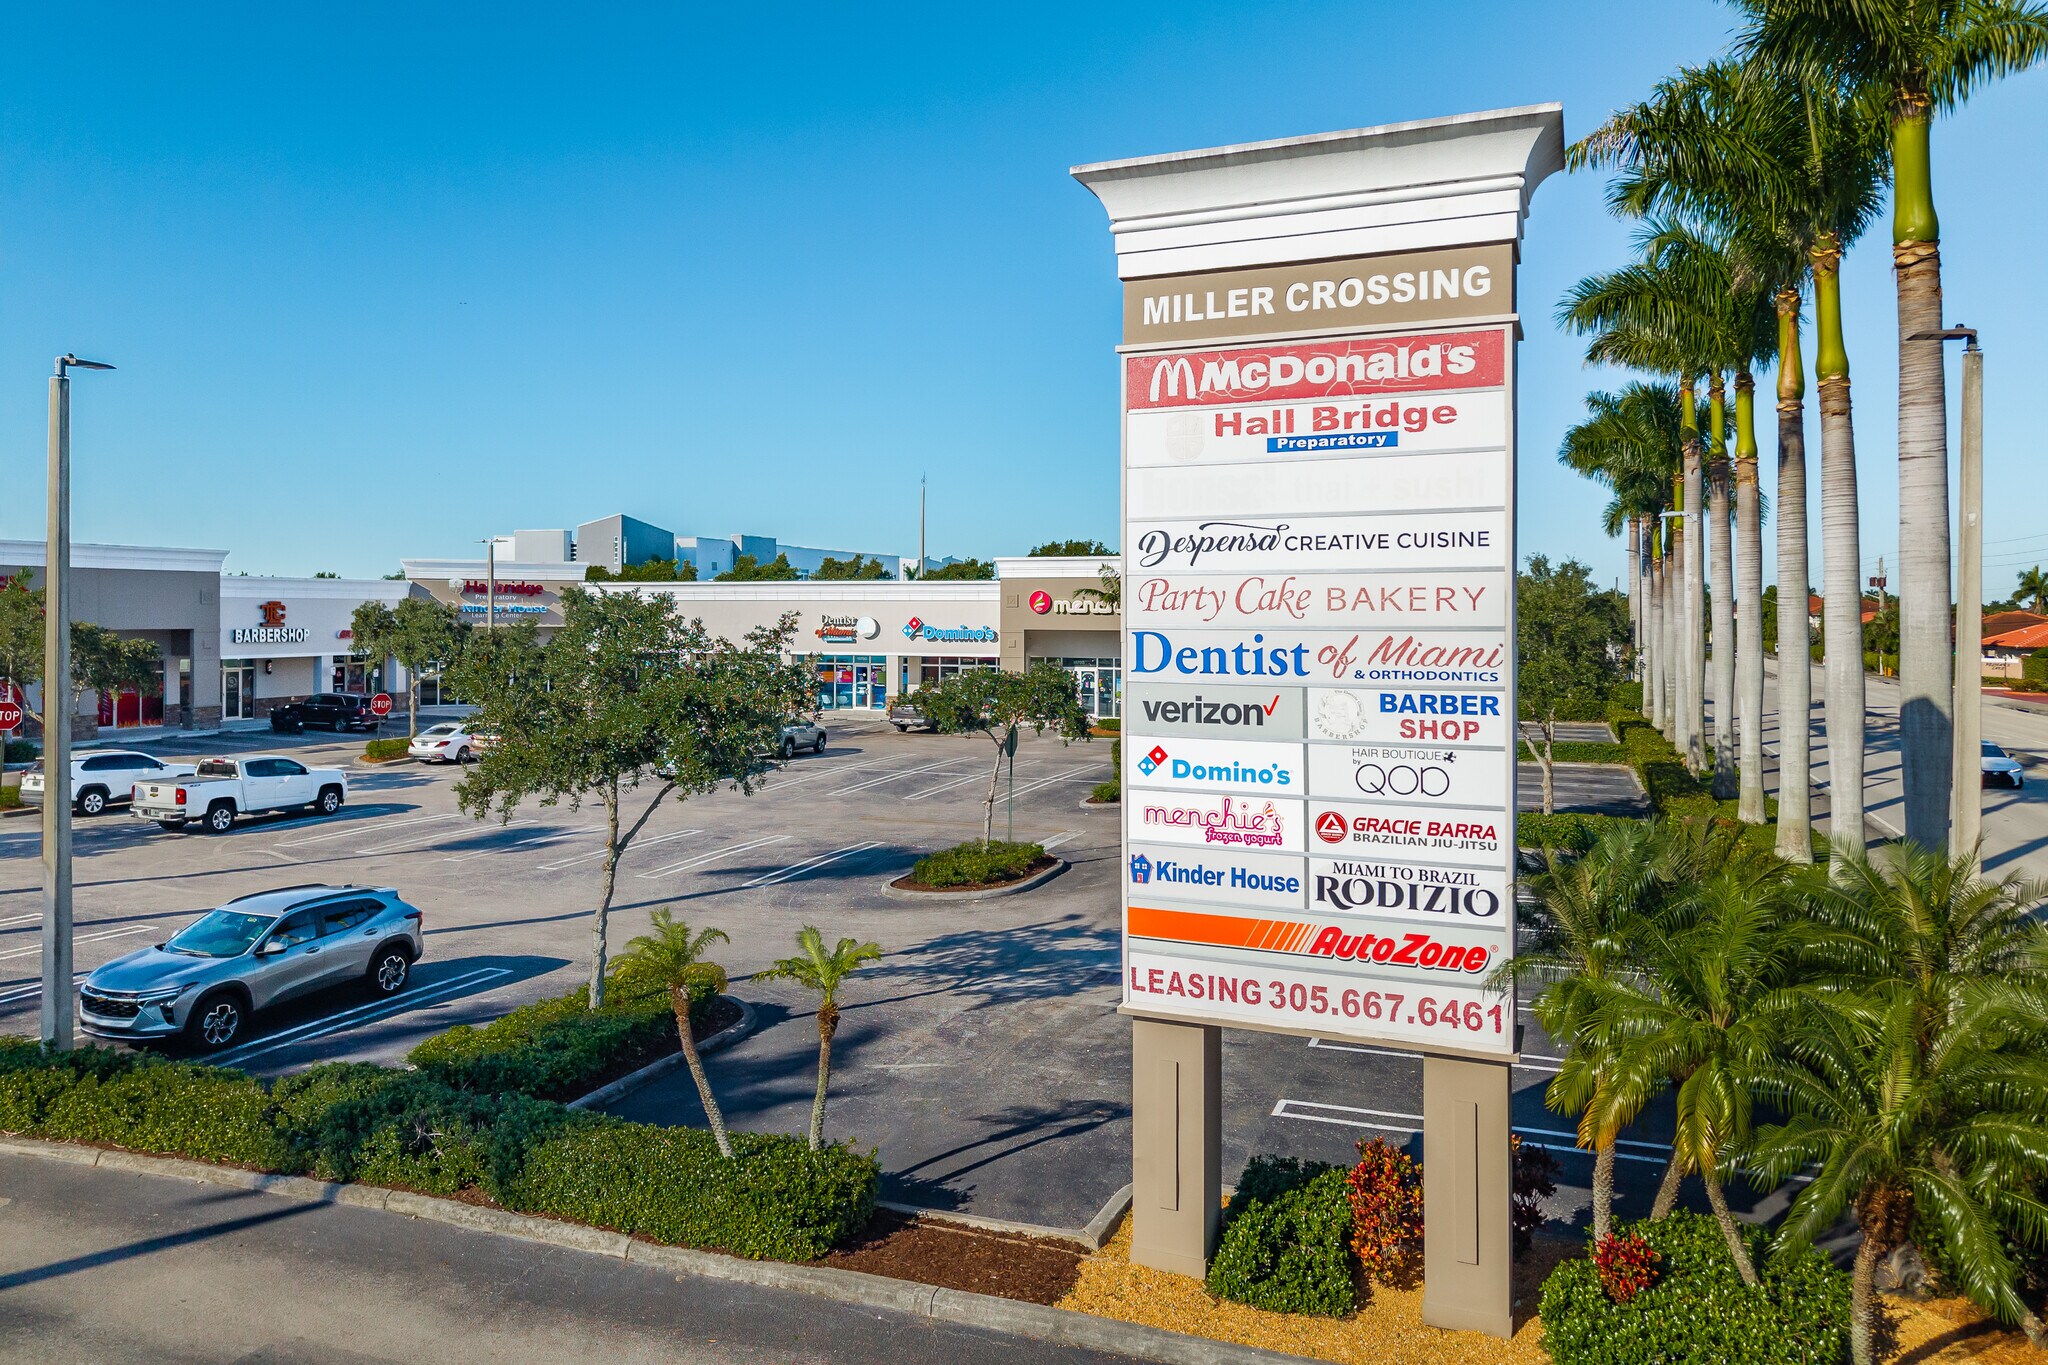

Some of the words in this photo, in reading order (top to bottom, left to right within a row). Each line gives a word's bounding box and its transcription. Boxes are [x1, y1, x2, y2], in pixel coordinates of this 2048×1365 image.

[1143, 286, 1275, 325] MILLER
[1285, 265, 1492, 312] CROSSING
[1199, 341, 1478, 393] McDonald's
[1214, 408, 1295, 438] Hall
[1312, 401, 1458, 434] Bridge
[1276, 433, 1388, 450] Preparatory
[1138, 522, 1290, 568] Despensa
[1284, 533, 1390, 551] CREATIVE
[1396, 530, 1490, 549] CUISINE
[465, 580, 544, 597] Habridge
[1138, 577, 1226, 622] Party
[1235, 576, 1312, 619] Cake
[1327, 586, 1487, 612] BAKERY
[821, 614, 855, 625] Dentist
[923, 624, 995, 640] Domino's
[234, 628, 310, 644] BARBERSHOP
[1131, 631, 1310, 676] Dentist
[1317, 634, 1357, 679] of
[1367, 635, 1504, 669] Miami
[1354, 669, 1365, 680] &
[1369, 670, 1500, 683] ORTHODONTICS
[0, 710, 20, 721] TOP
[372, 700, 391, 709] STOP
[1142, 695, 1264, 727] verizon
[1379, 693, 1501, 717] BARBER
[1314, 717, 1368, 740] BARBERSHOP
[1399, 719, 1480, 741] SHOP
[1352, 748, 1379, 758] HAIR
[1382, 749, 1442, 761] BOUTIQUE
[1171, 758, 1292, 786] Domino's
[1355, 763, 1450, 797] QOD
[1143, 796, 1283, 832] menchie's
[1205, 828, 1242, 844] frozen
[1244, 830, 1283, 847] yogurt
[1352, 816, 1424, 835] GRACIE
[1427, 821, 1498, 840] BARRA
[1353, 832, 1428, 848] BRAZILIAN
[1431, 837, 1498, 852] JIU-JITSU
[1156, 860, 1225, 888] Kinder
[1230, 867, 1300, 893] House
[1332, 861, 1386, 880] MIAMI
[1389, 866, 1414, 882] TO
[1418, 868, 1480, 887] BRAZIL
[1315, 875, 1499, 918] RODIZIO
[1309, 926, 1490, 973] AutoZone
[1131, 966, 1262, 1006] LEASING
[1268, 980, 1503, 1034] 305.667.6461
